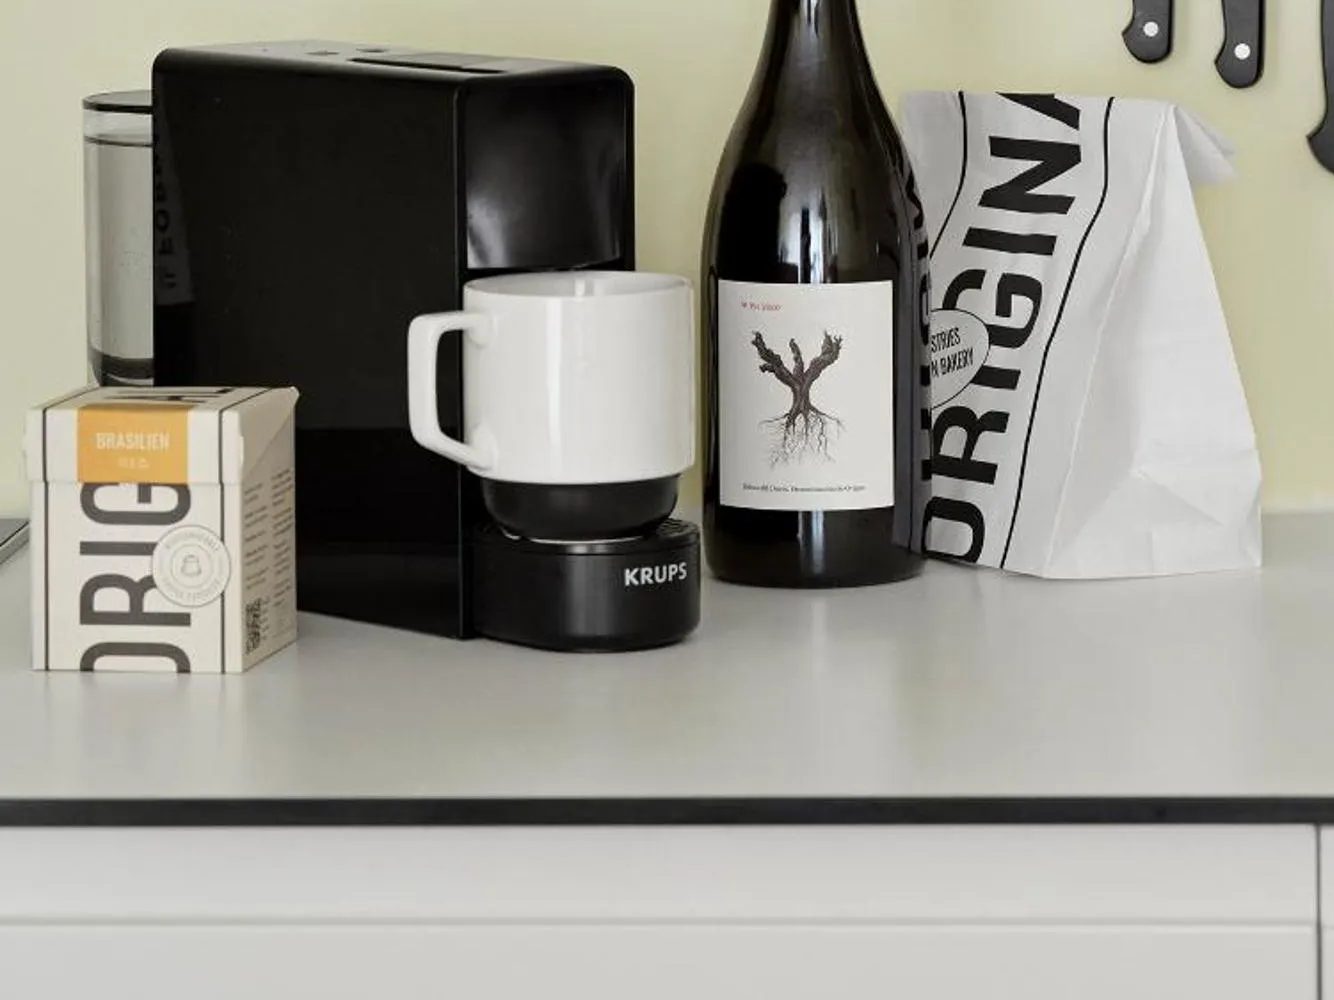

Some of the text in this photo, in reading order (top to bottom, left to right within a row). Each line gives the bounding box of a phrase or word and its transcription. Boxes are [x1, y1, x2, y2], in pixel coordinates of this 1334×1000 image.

[931, 327, 961, 353] STRIES
[940, 347, 974, 376] BAKERY
[96, 432, 170, 450] BRASILIEN
[624, 562, 687, 586] KRUPS
